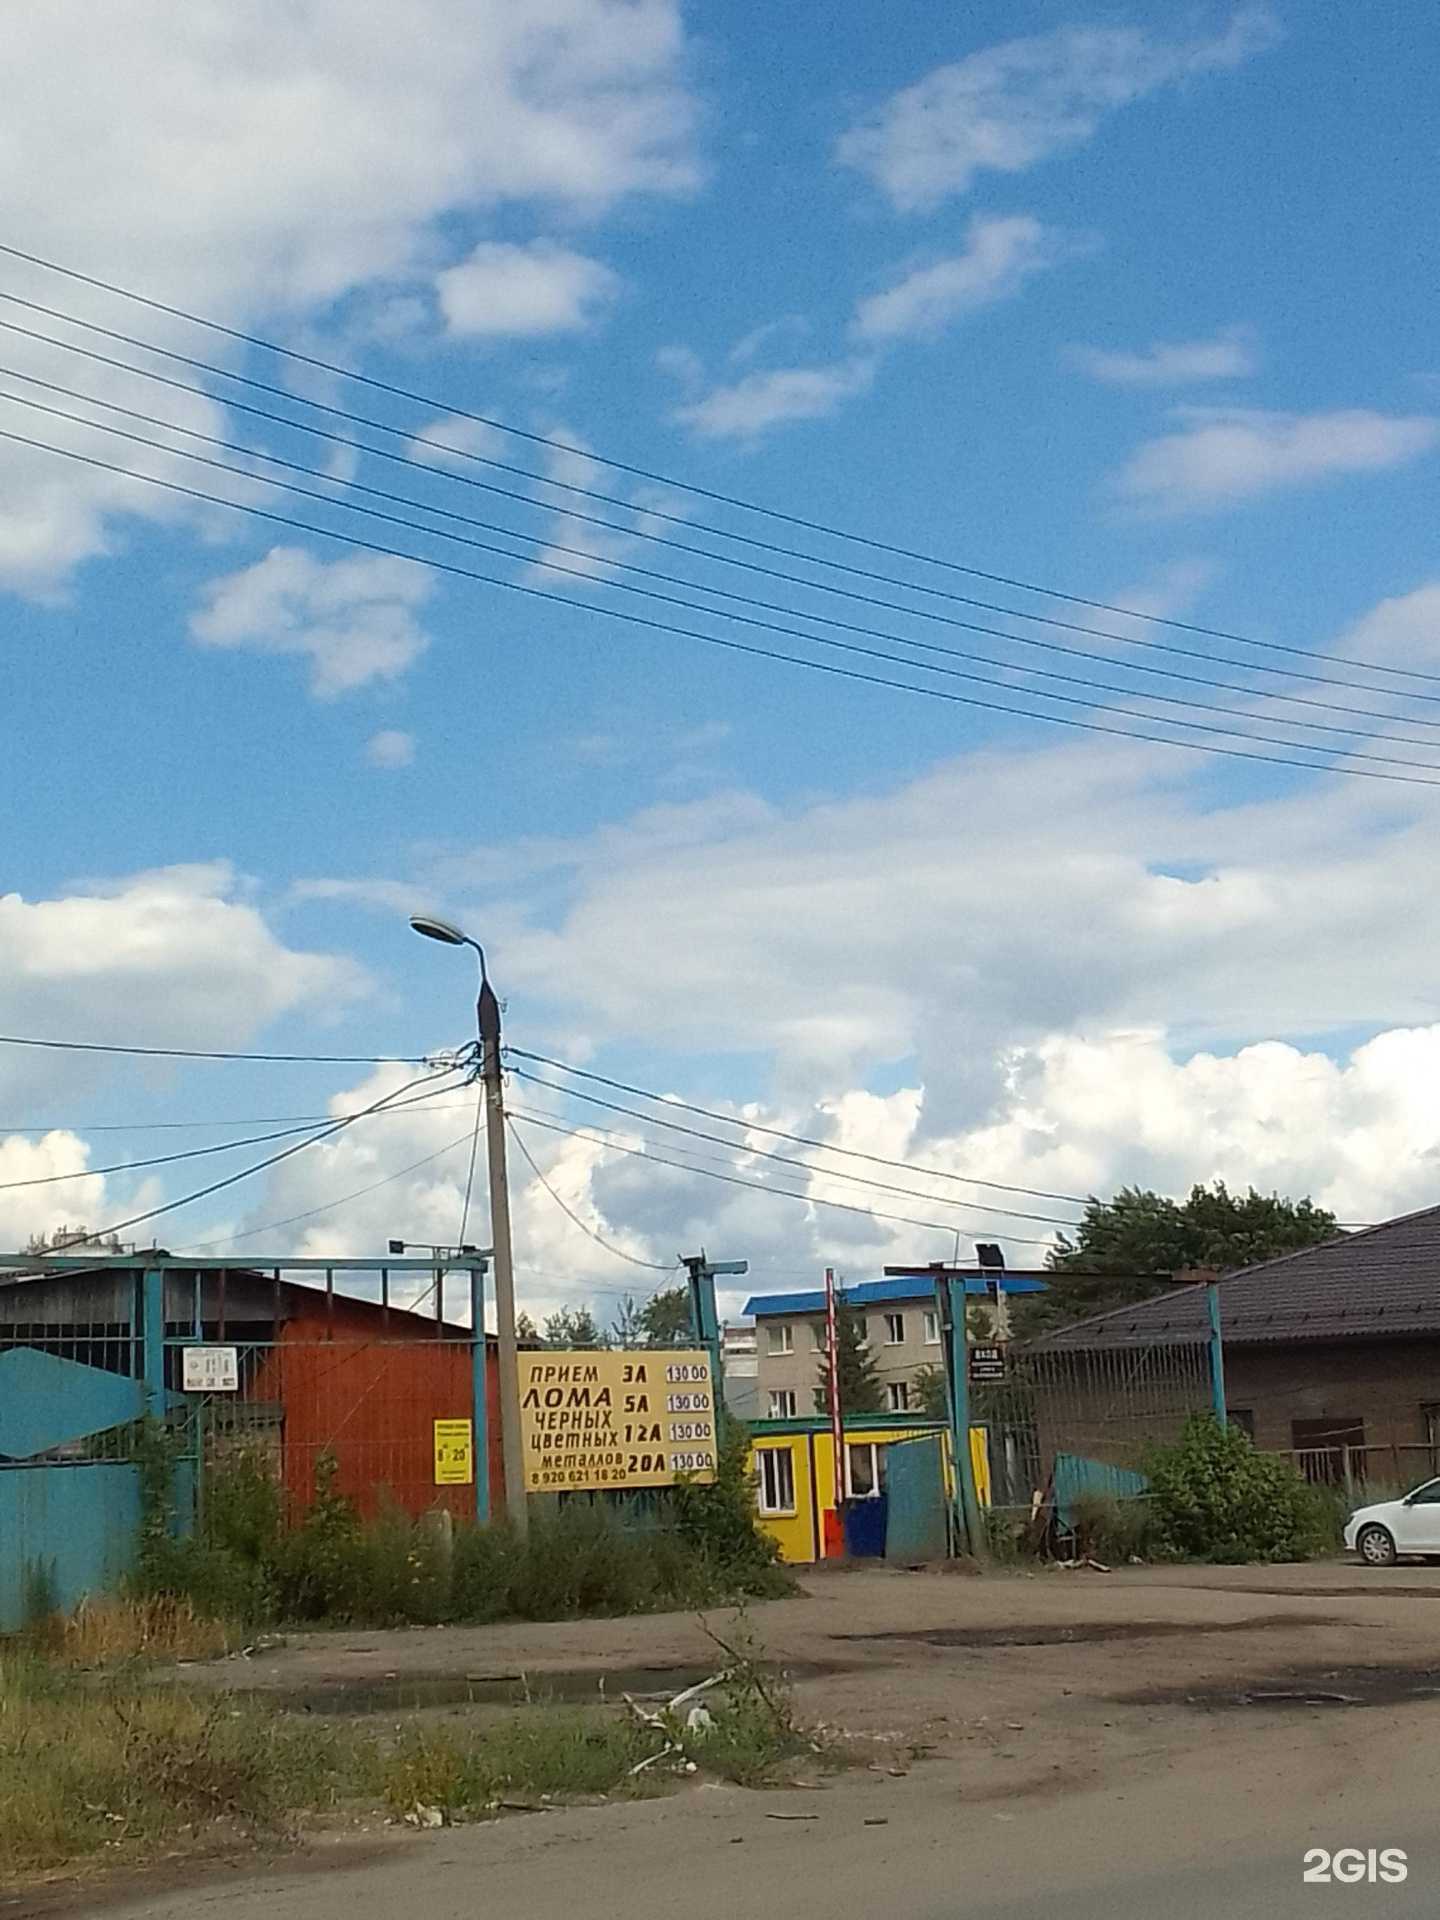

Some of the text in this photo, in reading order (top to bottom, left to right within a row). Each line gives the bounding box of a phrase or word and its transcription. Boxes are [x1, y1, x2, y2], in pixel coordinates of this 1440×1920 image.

[530, 1366, 599, 1383] ПРИЕМ
[622, 1365, 647, 1383] 3А
[522, 1387, 612, 1409] ЛОМА
[624, 1395, 649, 1413] 5А
[535, 1410, 612, 1430] ЧЕРНЫХ
[612, 1468, 626, 1480] 20
